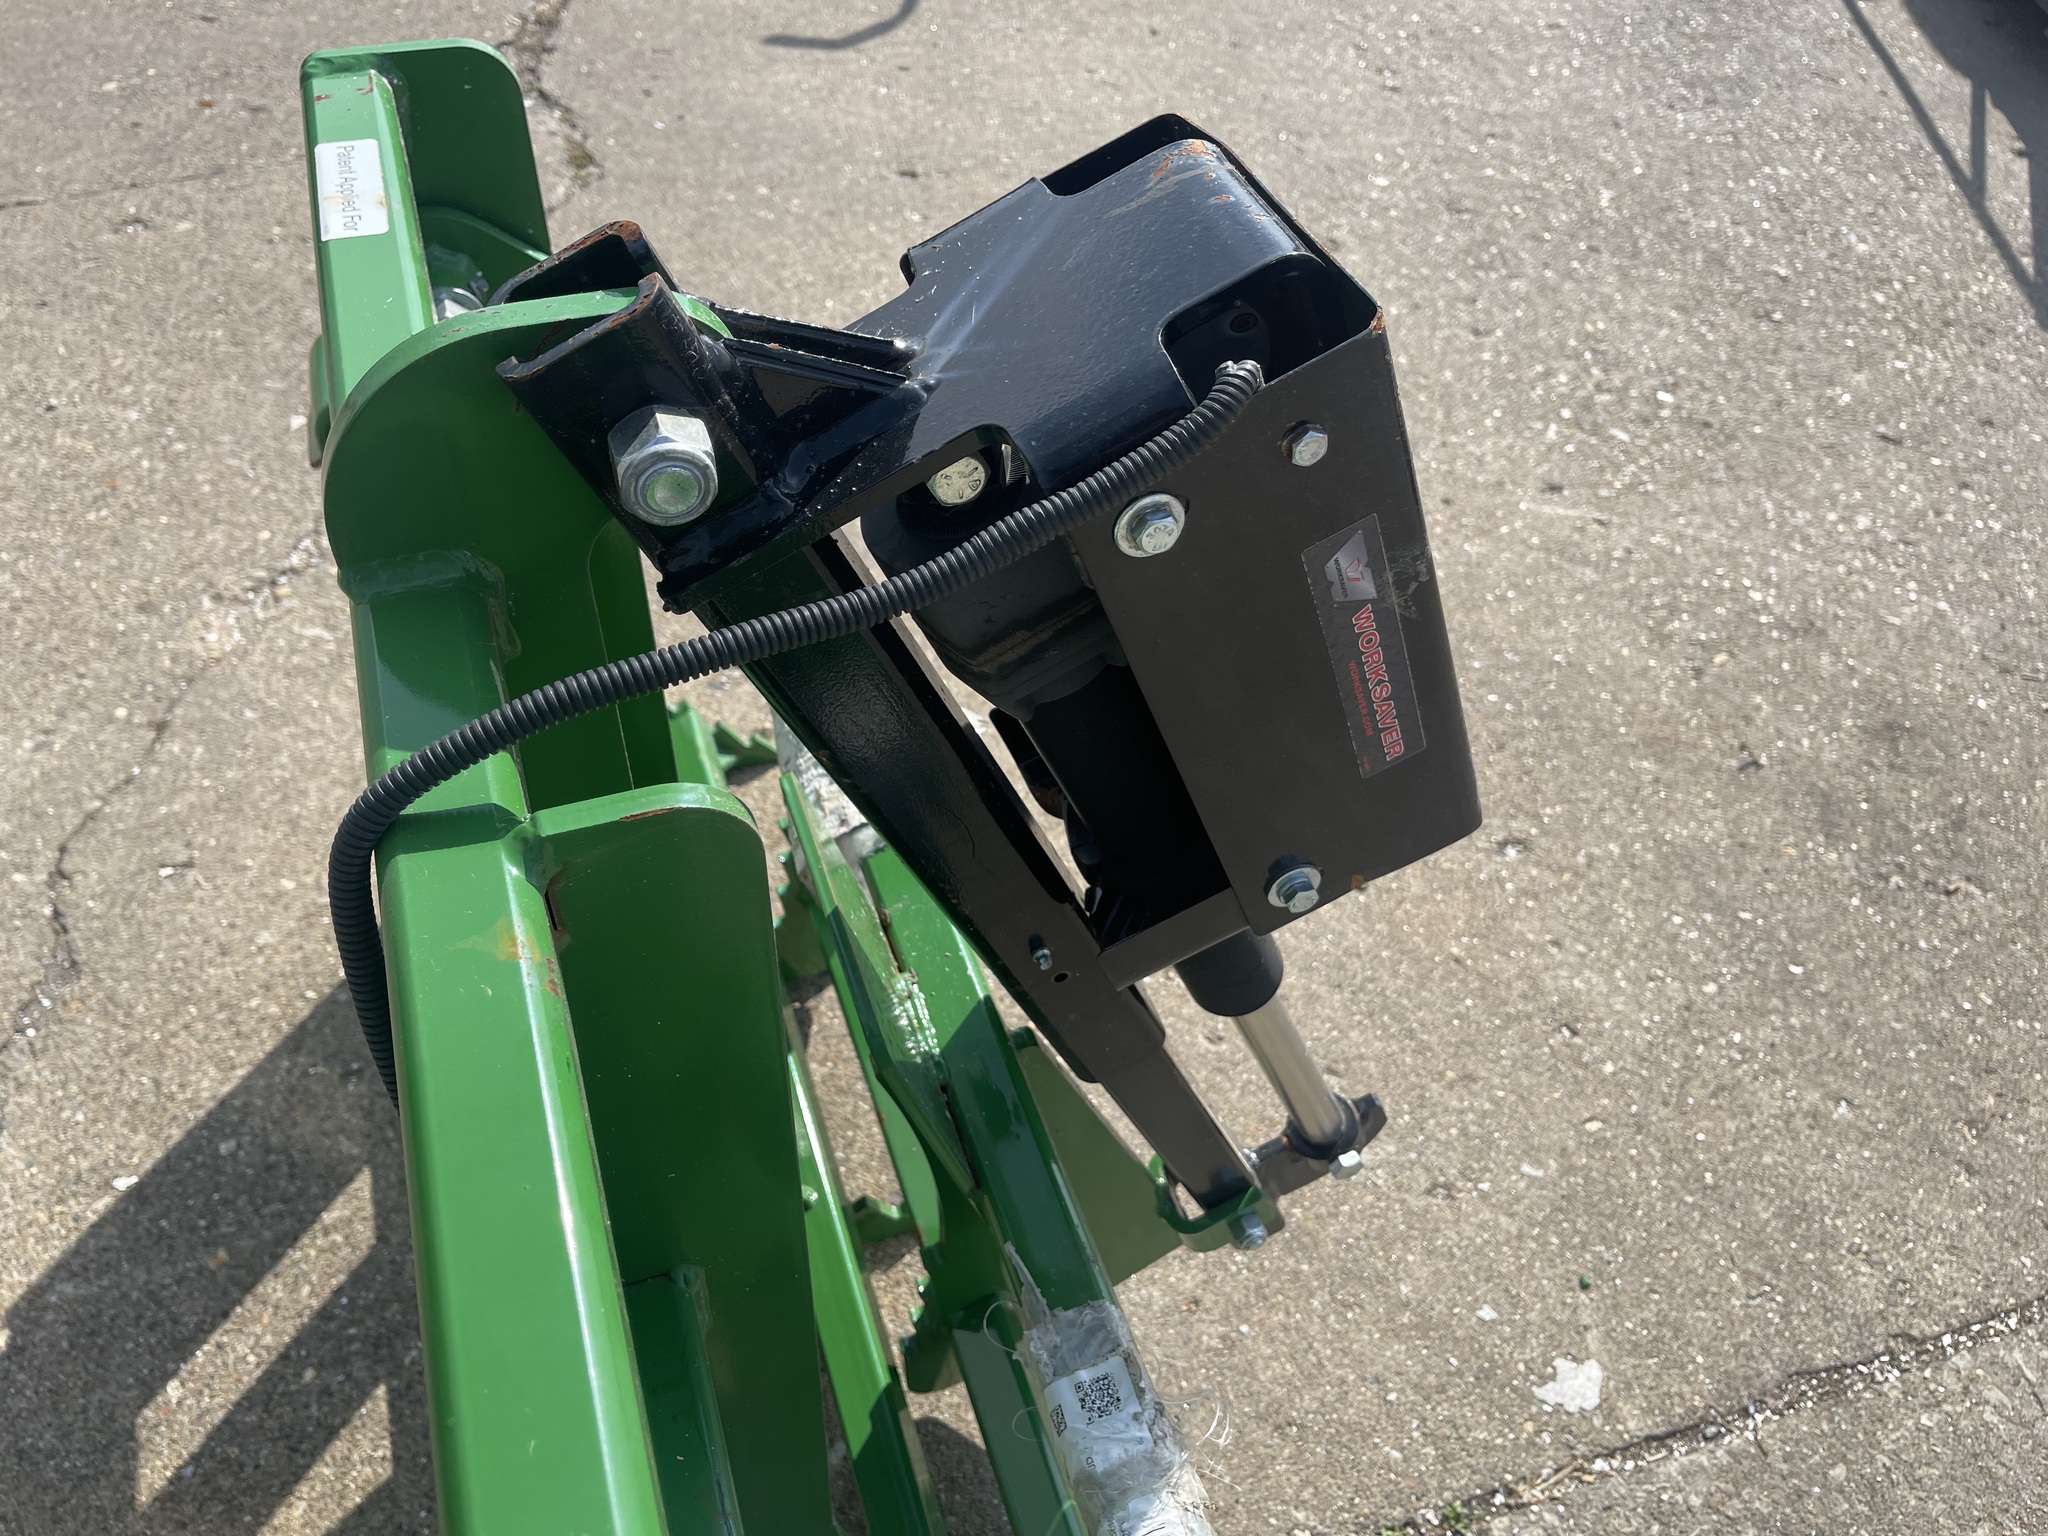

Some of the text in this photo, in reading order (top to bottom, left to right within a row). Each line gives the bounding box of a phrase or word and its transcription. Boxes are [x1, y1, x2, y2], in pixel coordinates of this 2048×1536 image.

[335, 145, 362, 231] Patent Applied For
[1333, 557, 1349, 599] WORKSAVER
[1349, 660, 1374, 737] WORKSAVER.COM
[1352, 604, 1404, 762] WORKSAVER
